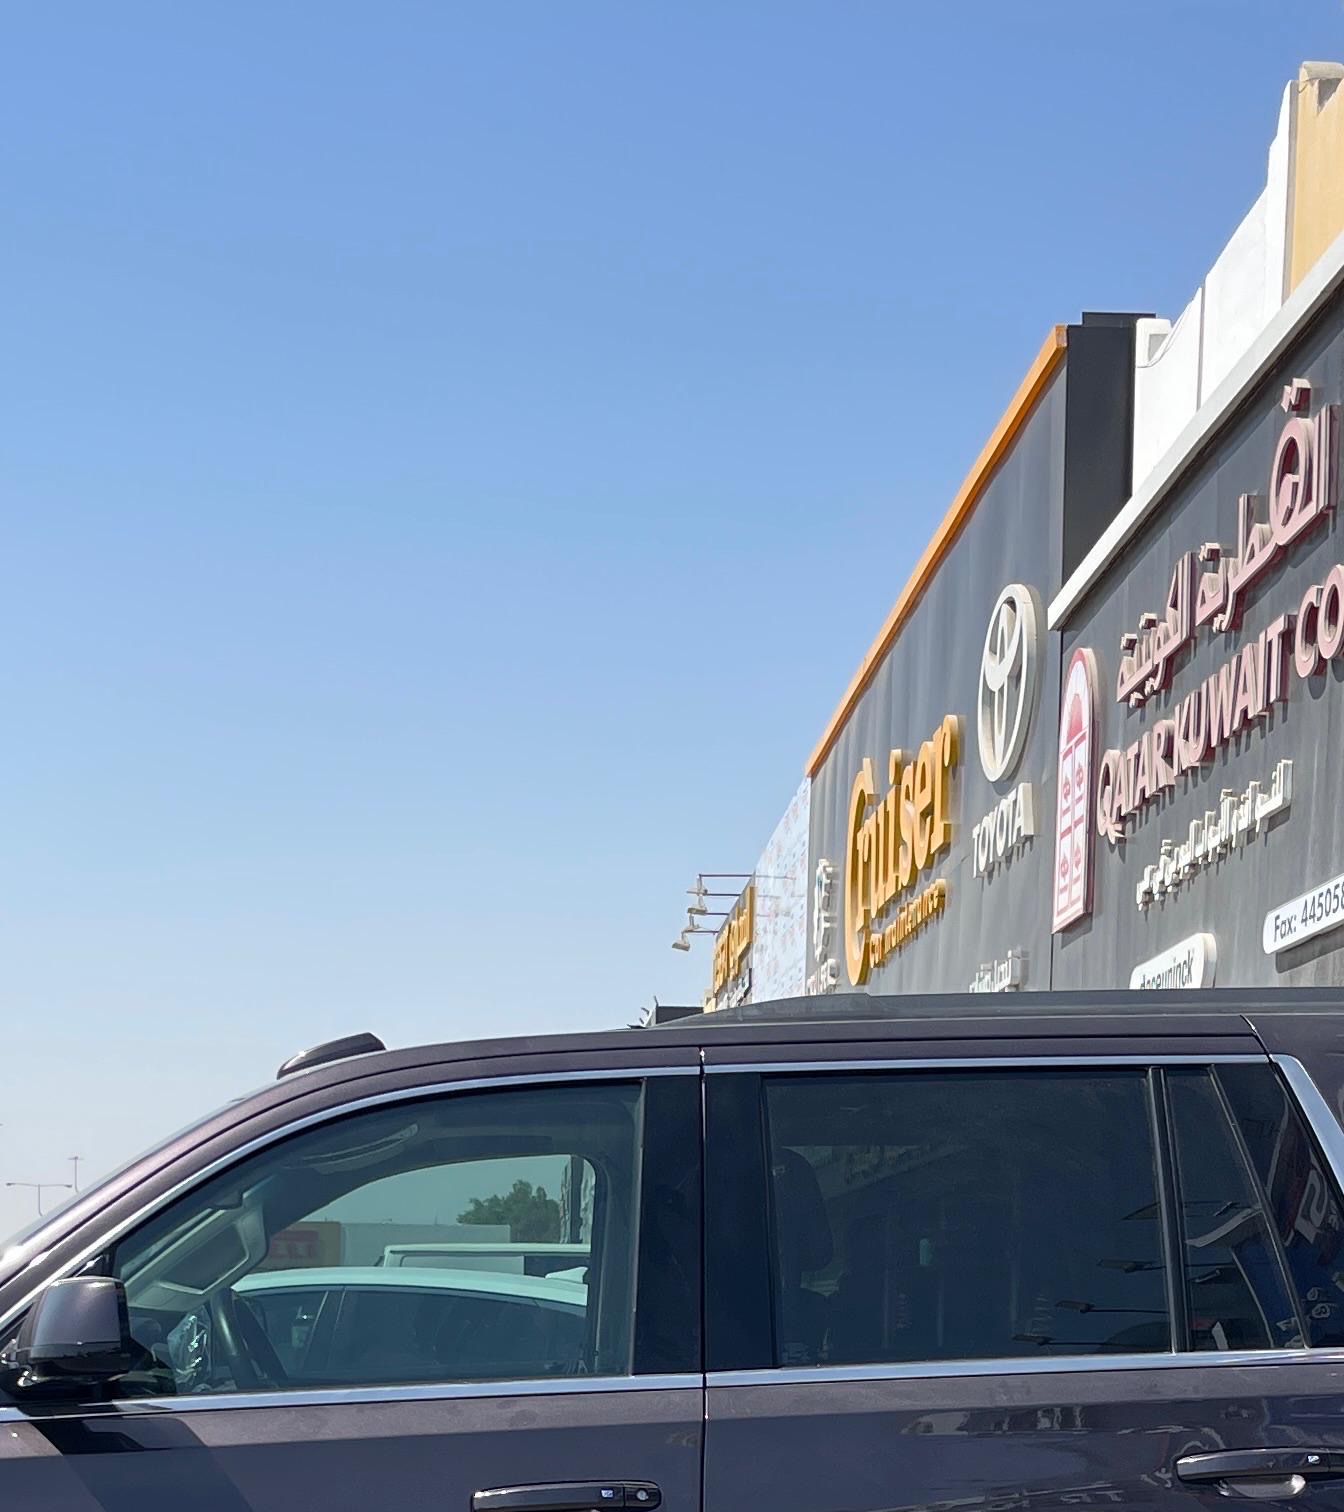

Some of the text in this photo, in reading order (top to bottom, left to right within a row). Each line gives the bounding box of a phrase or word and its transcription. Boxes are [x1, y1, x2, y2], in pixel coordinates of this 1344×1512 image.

[1097, 719, 1176, 845] QATAR
[1173, 613, 1296, 778] KUWAIT
[845, 715, 958, 987] Cruiser
[972, 782, 1034, 879] TOYOTA
[1273, 911, 1297, 943] Fax:
